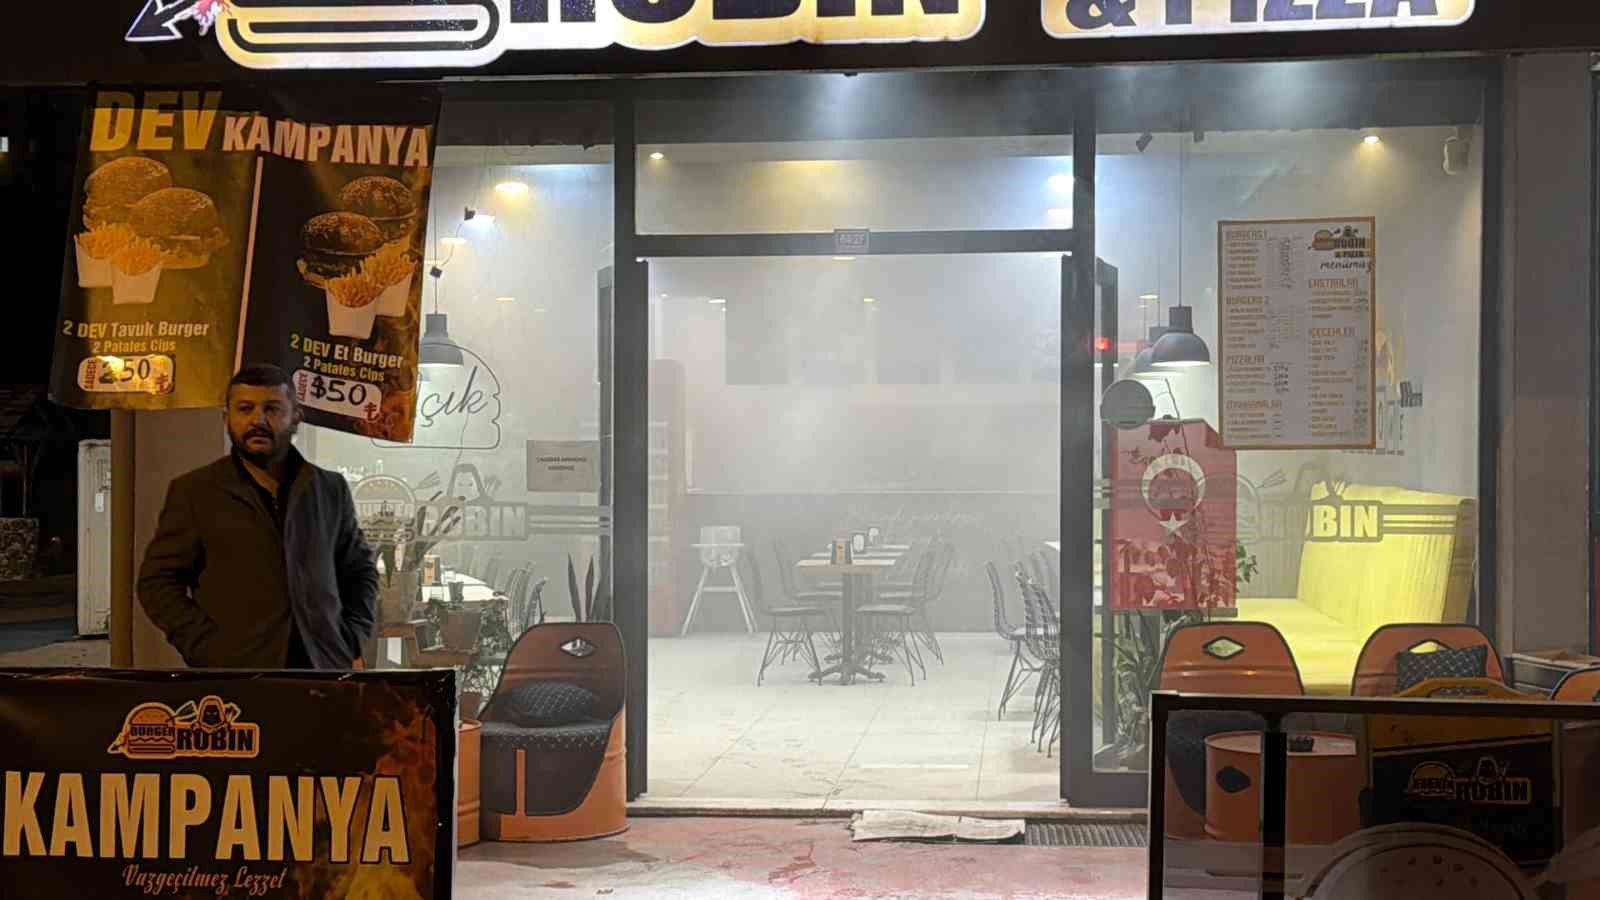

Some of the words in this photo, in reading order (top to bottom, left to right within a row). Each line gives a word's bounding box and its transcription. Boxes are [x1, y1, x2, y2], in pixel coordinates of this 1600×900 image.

[90, 91, 222, 151] DEV
[222, 115, 430, 167] KAMPANYA
[62, 320, 73, 336] 2
[77, 322, 106, 338] DEV
[110, 321, 154, 337] Tavuk
[158, 321, 210, 338] Burger
[92, 341, 100, 353] 2
[103, 341, 147, 353] Patates
[150, 339, 176, 353] Cips
[290, 334, 300, 349] 2
[303, 338, 331, 357] DEV
[334, 345, 349, 360] Et
[353, 347, 405, 369] Burger
[303, 356, 311, 367] 2
[313, 359, 356, 377] Patates
[360, 366, 385, 381] Cips
[420, 366, 488, 428] çık
[130, 726, 175, 737] BURGER
[177, 729, 254, 751] ROBIN
[3, 771, 410, 863] KAMPANYA
[122, 864, 229, 896] Vazgeçilmez
[234, 865, 288, 896] Lezzet
